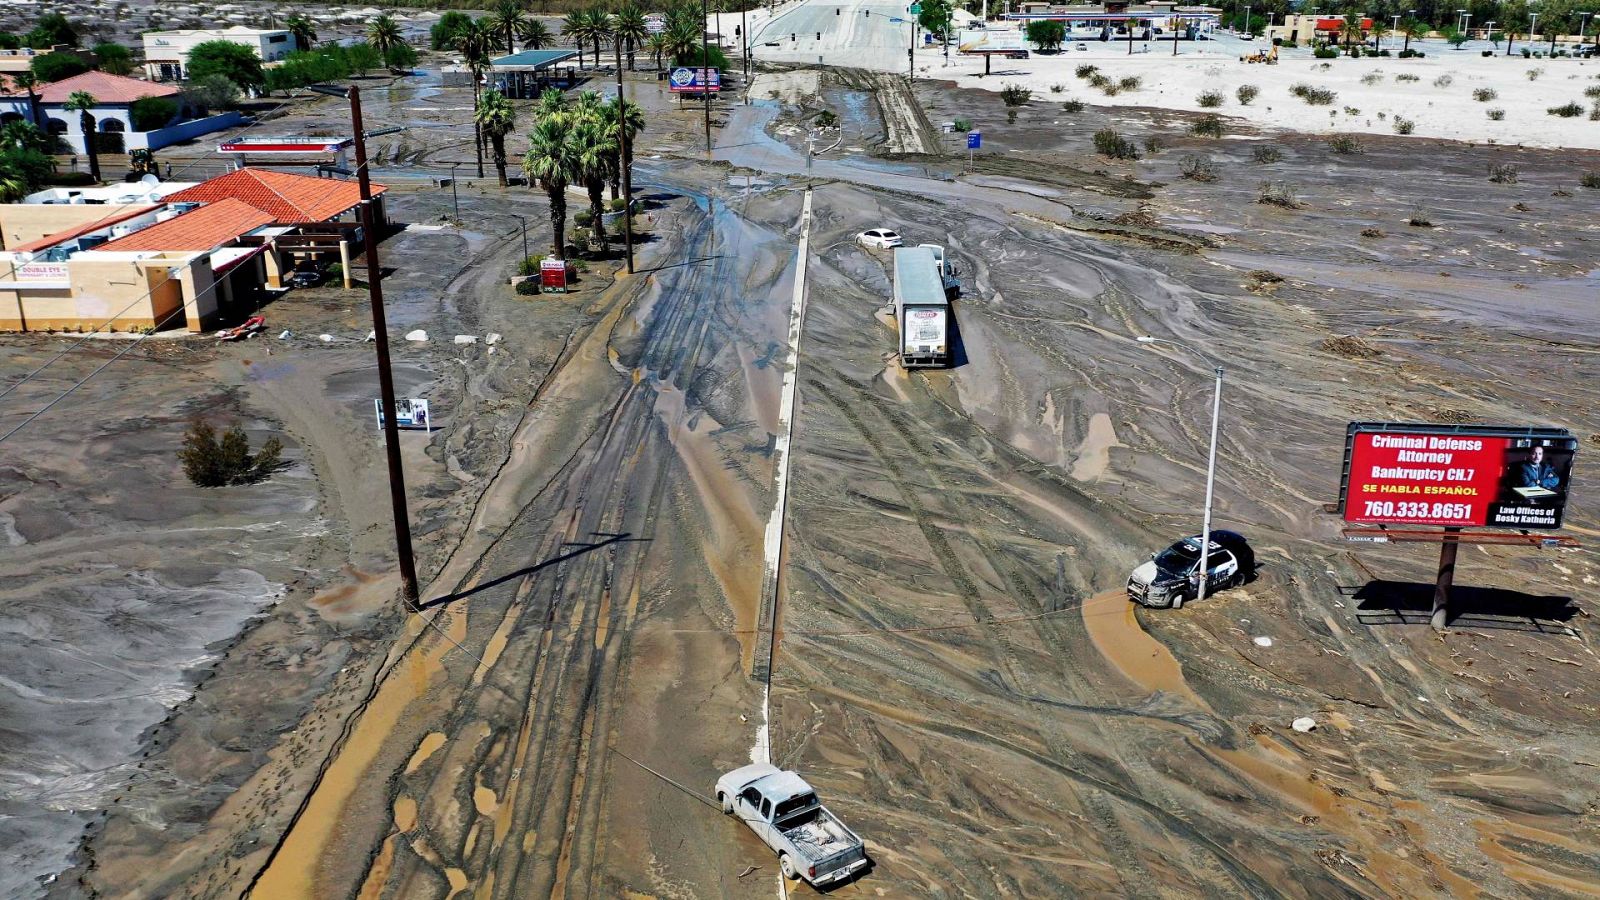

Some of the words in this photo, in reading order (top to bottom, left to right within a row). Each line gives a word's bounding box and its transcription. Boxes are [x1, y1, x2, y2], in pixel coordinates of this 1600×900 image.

[1372, 435, 1426, 449] Criminal
[1429, 437, 1482, 451] Defense
[1397, 449, 1453, 465] Attorney
[1371, 466, 1445, 481] Bankruptcy
[1447, 468, 1475, 481] CH.7
[1362, 484, 1377, 492] SE
[1381, 485, 1420, 494] HABLA
[1424, 485, 1478, 496] ESPAÑOL
[1364, 501, 1472, 519] 760.333.8651
[1499, 506, 1515, 514] Law
[1516, 506, 1545, 515] Offices
[1546, 508, 1555, 516] of
[1495, 514, 1520, 523] Bosky
[1520, 516, 1556, 525] Kathuria
